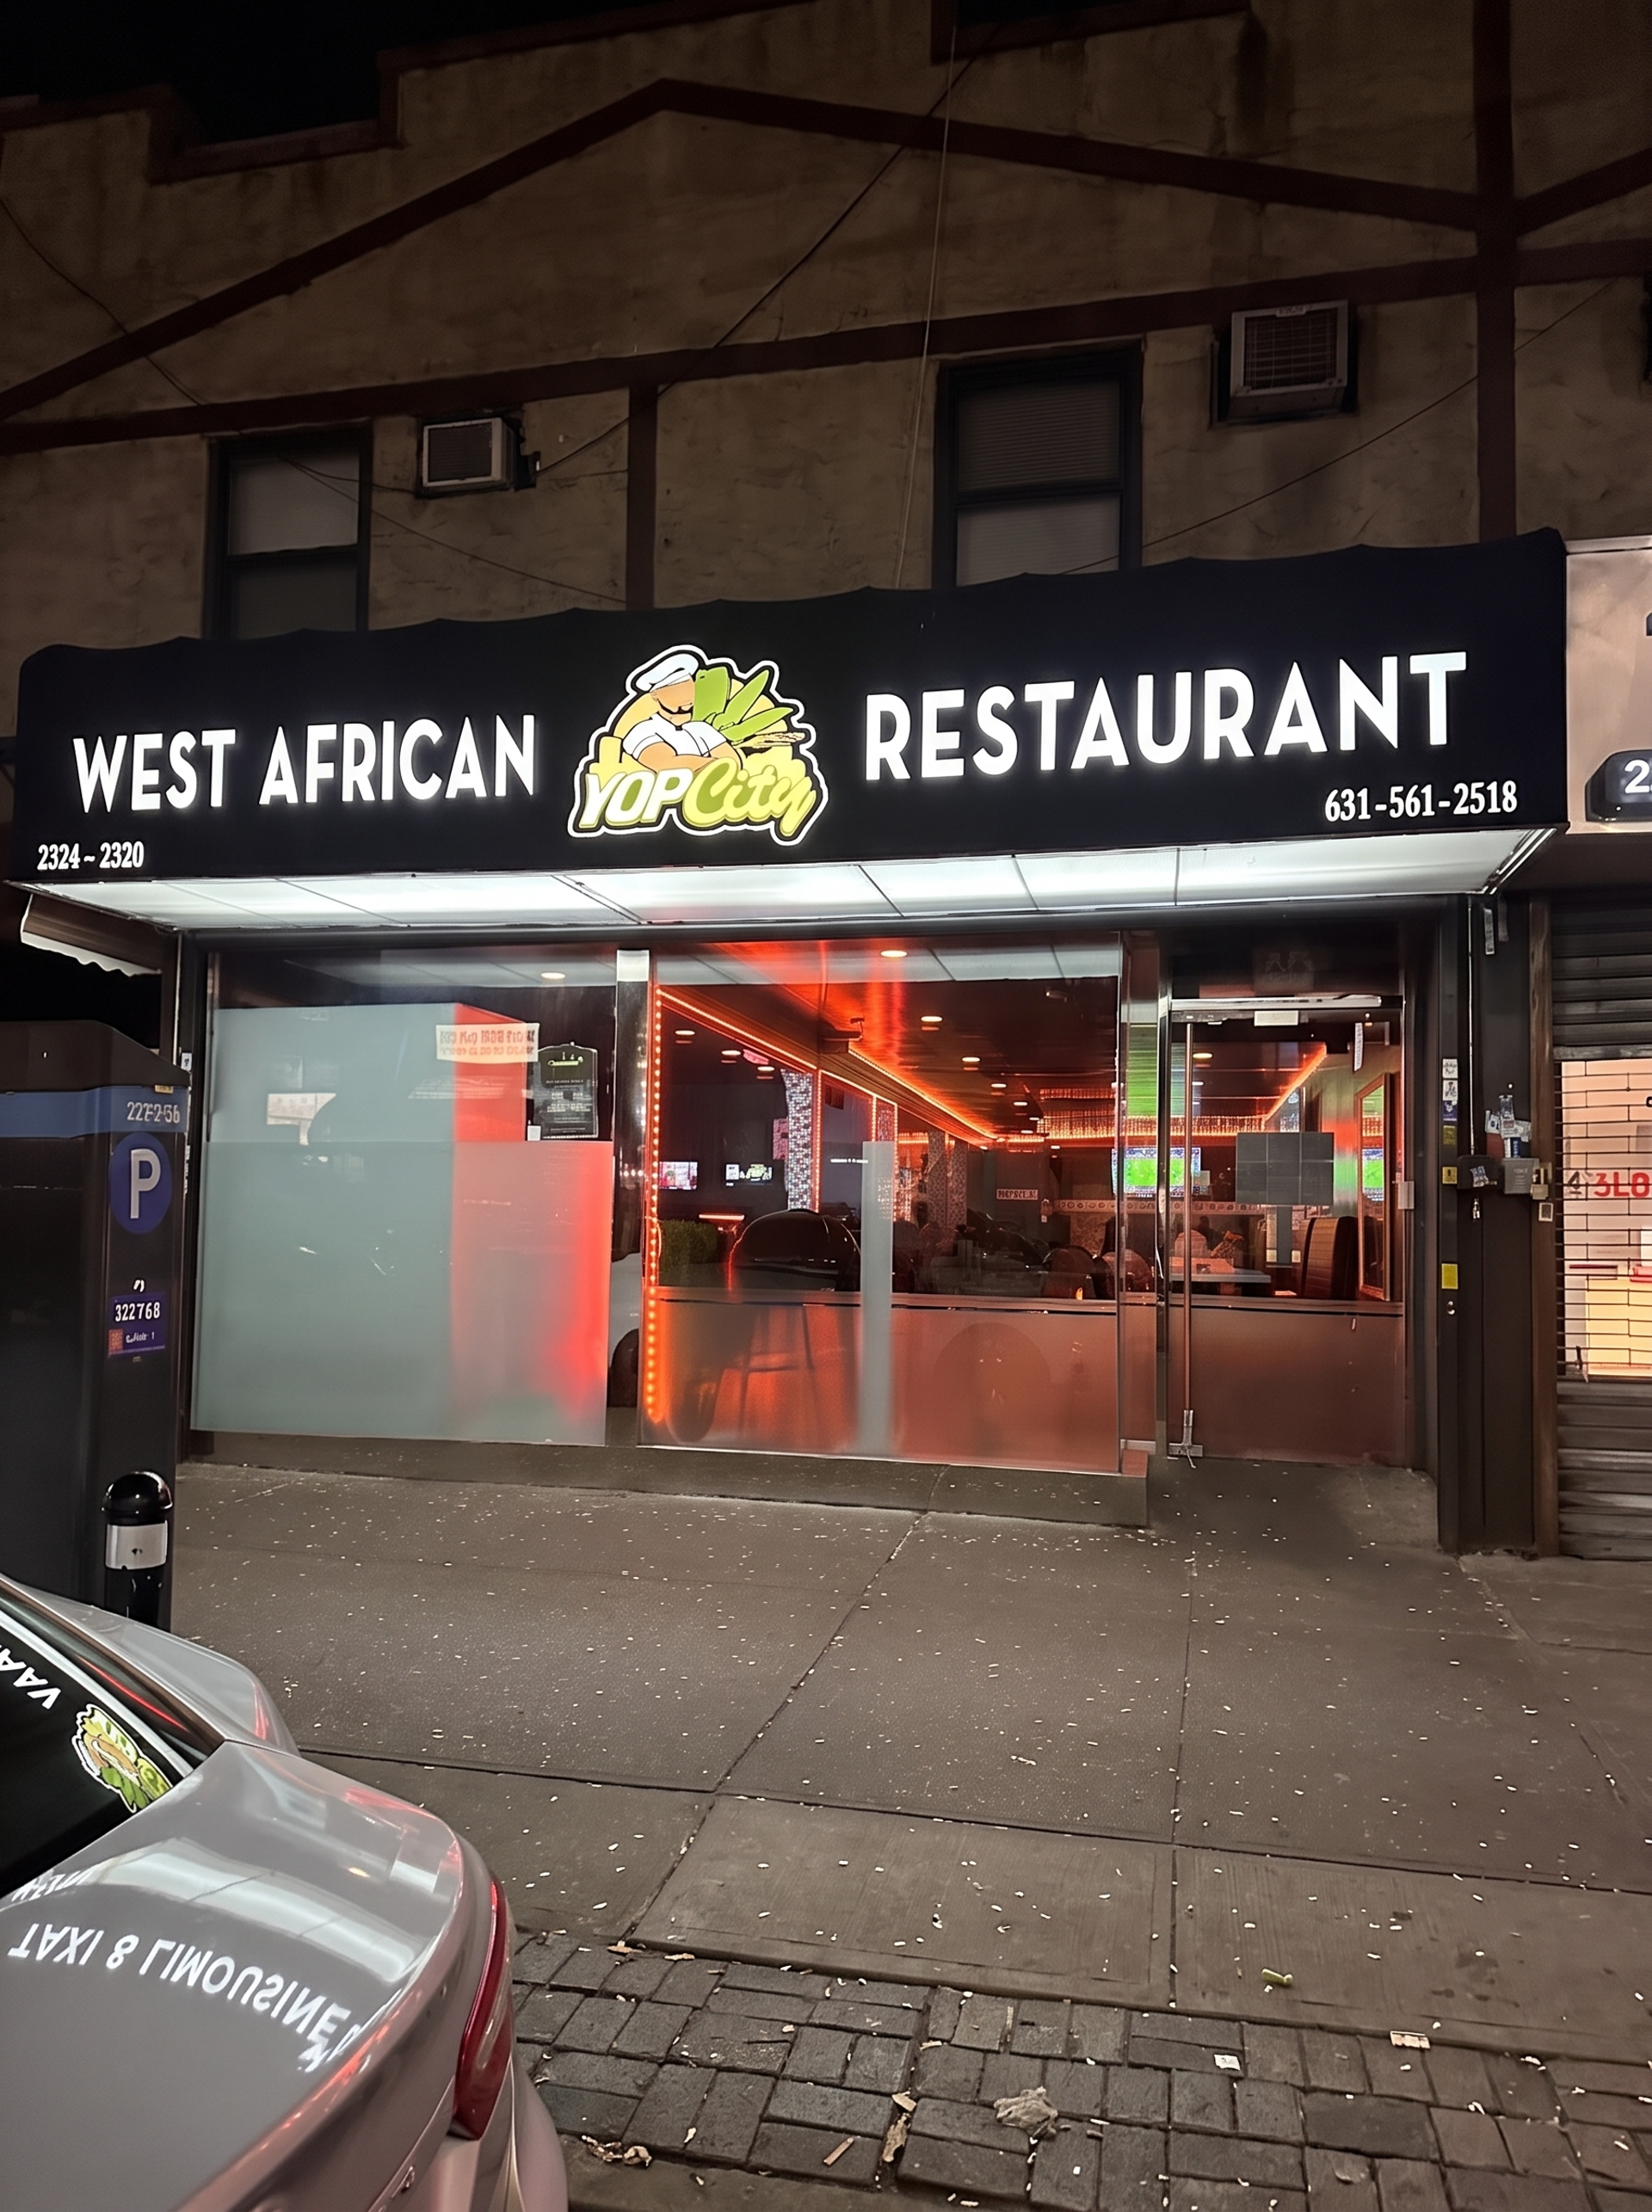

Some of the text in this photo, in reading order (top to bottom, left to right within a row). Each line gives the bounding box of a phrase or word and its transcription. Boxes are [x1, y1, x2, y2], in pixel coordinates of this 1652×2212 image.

[866, 651, 1467, 781] RESTAURANT
[72, 714, 534, 813] WEST AFRICAN
[577, 756, 817, 837] YOP City
[1624, 759, 1652, 794] 2
[1324, 779, 1518, 823] 631-561-2518
[130, 1149, 161, 1219] P
[115, 1302, 160, 1322] 322768
